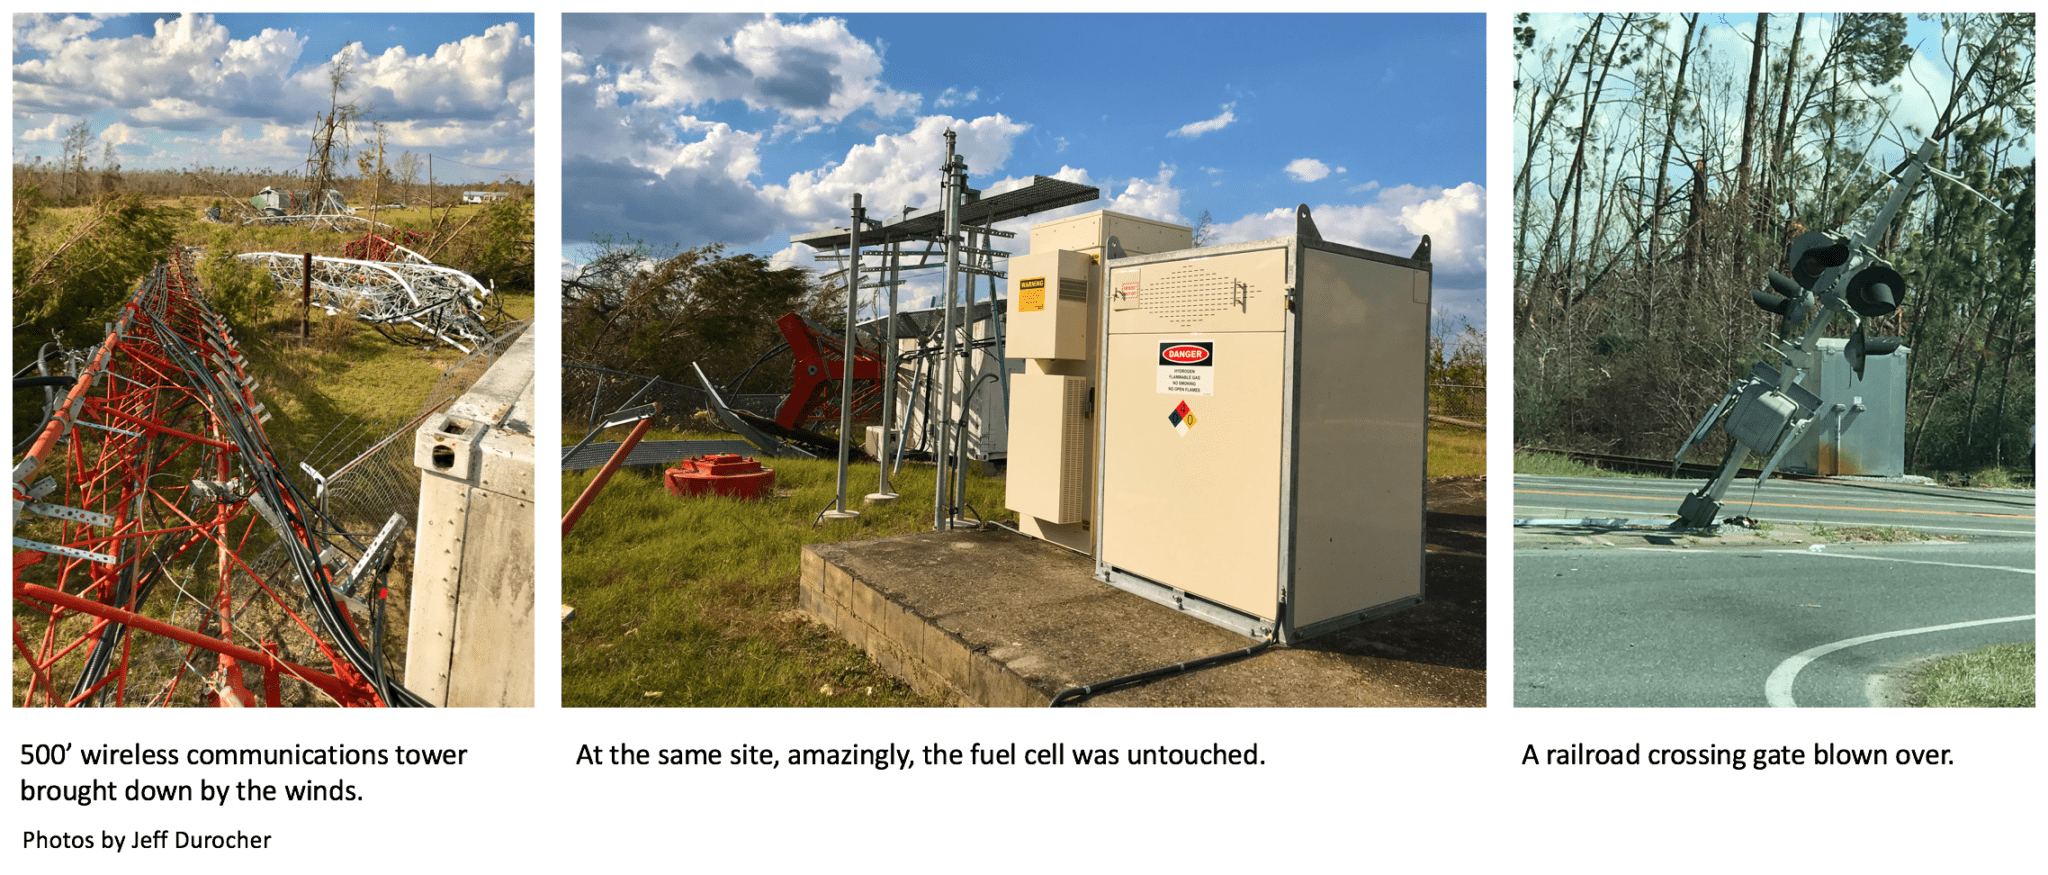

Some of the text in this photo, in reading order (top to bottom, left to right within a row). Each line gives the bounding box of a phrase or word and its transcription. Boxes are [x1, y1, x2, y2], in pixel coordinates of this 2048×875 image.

[1021, 280, 1043, 288] WARNING
[1169, 350, 1202, 358] DANGER
[1180, 404, 1186, 414] 4
[1187, 414, 1193, 425] 0
